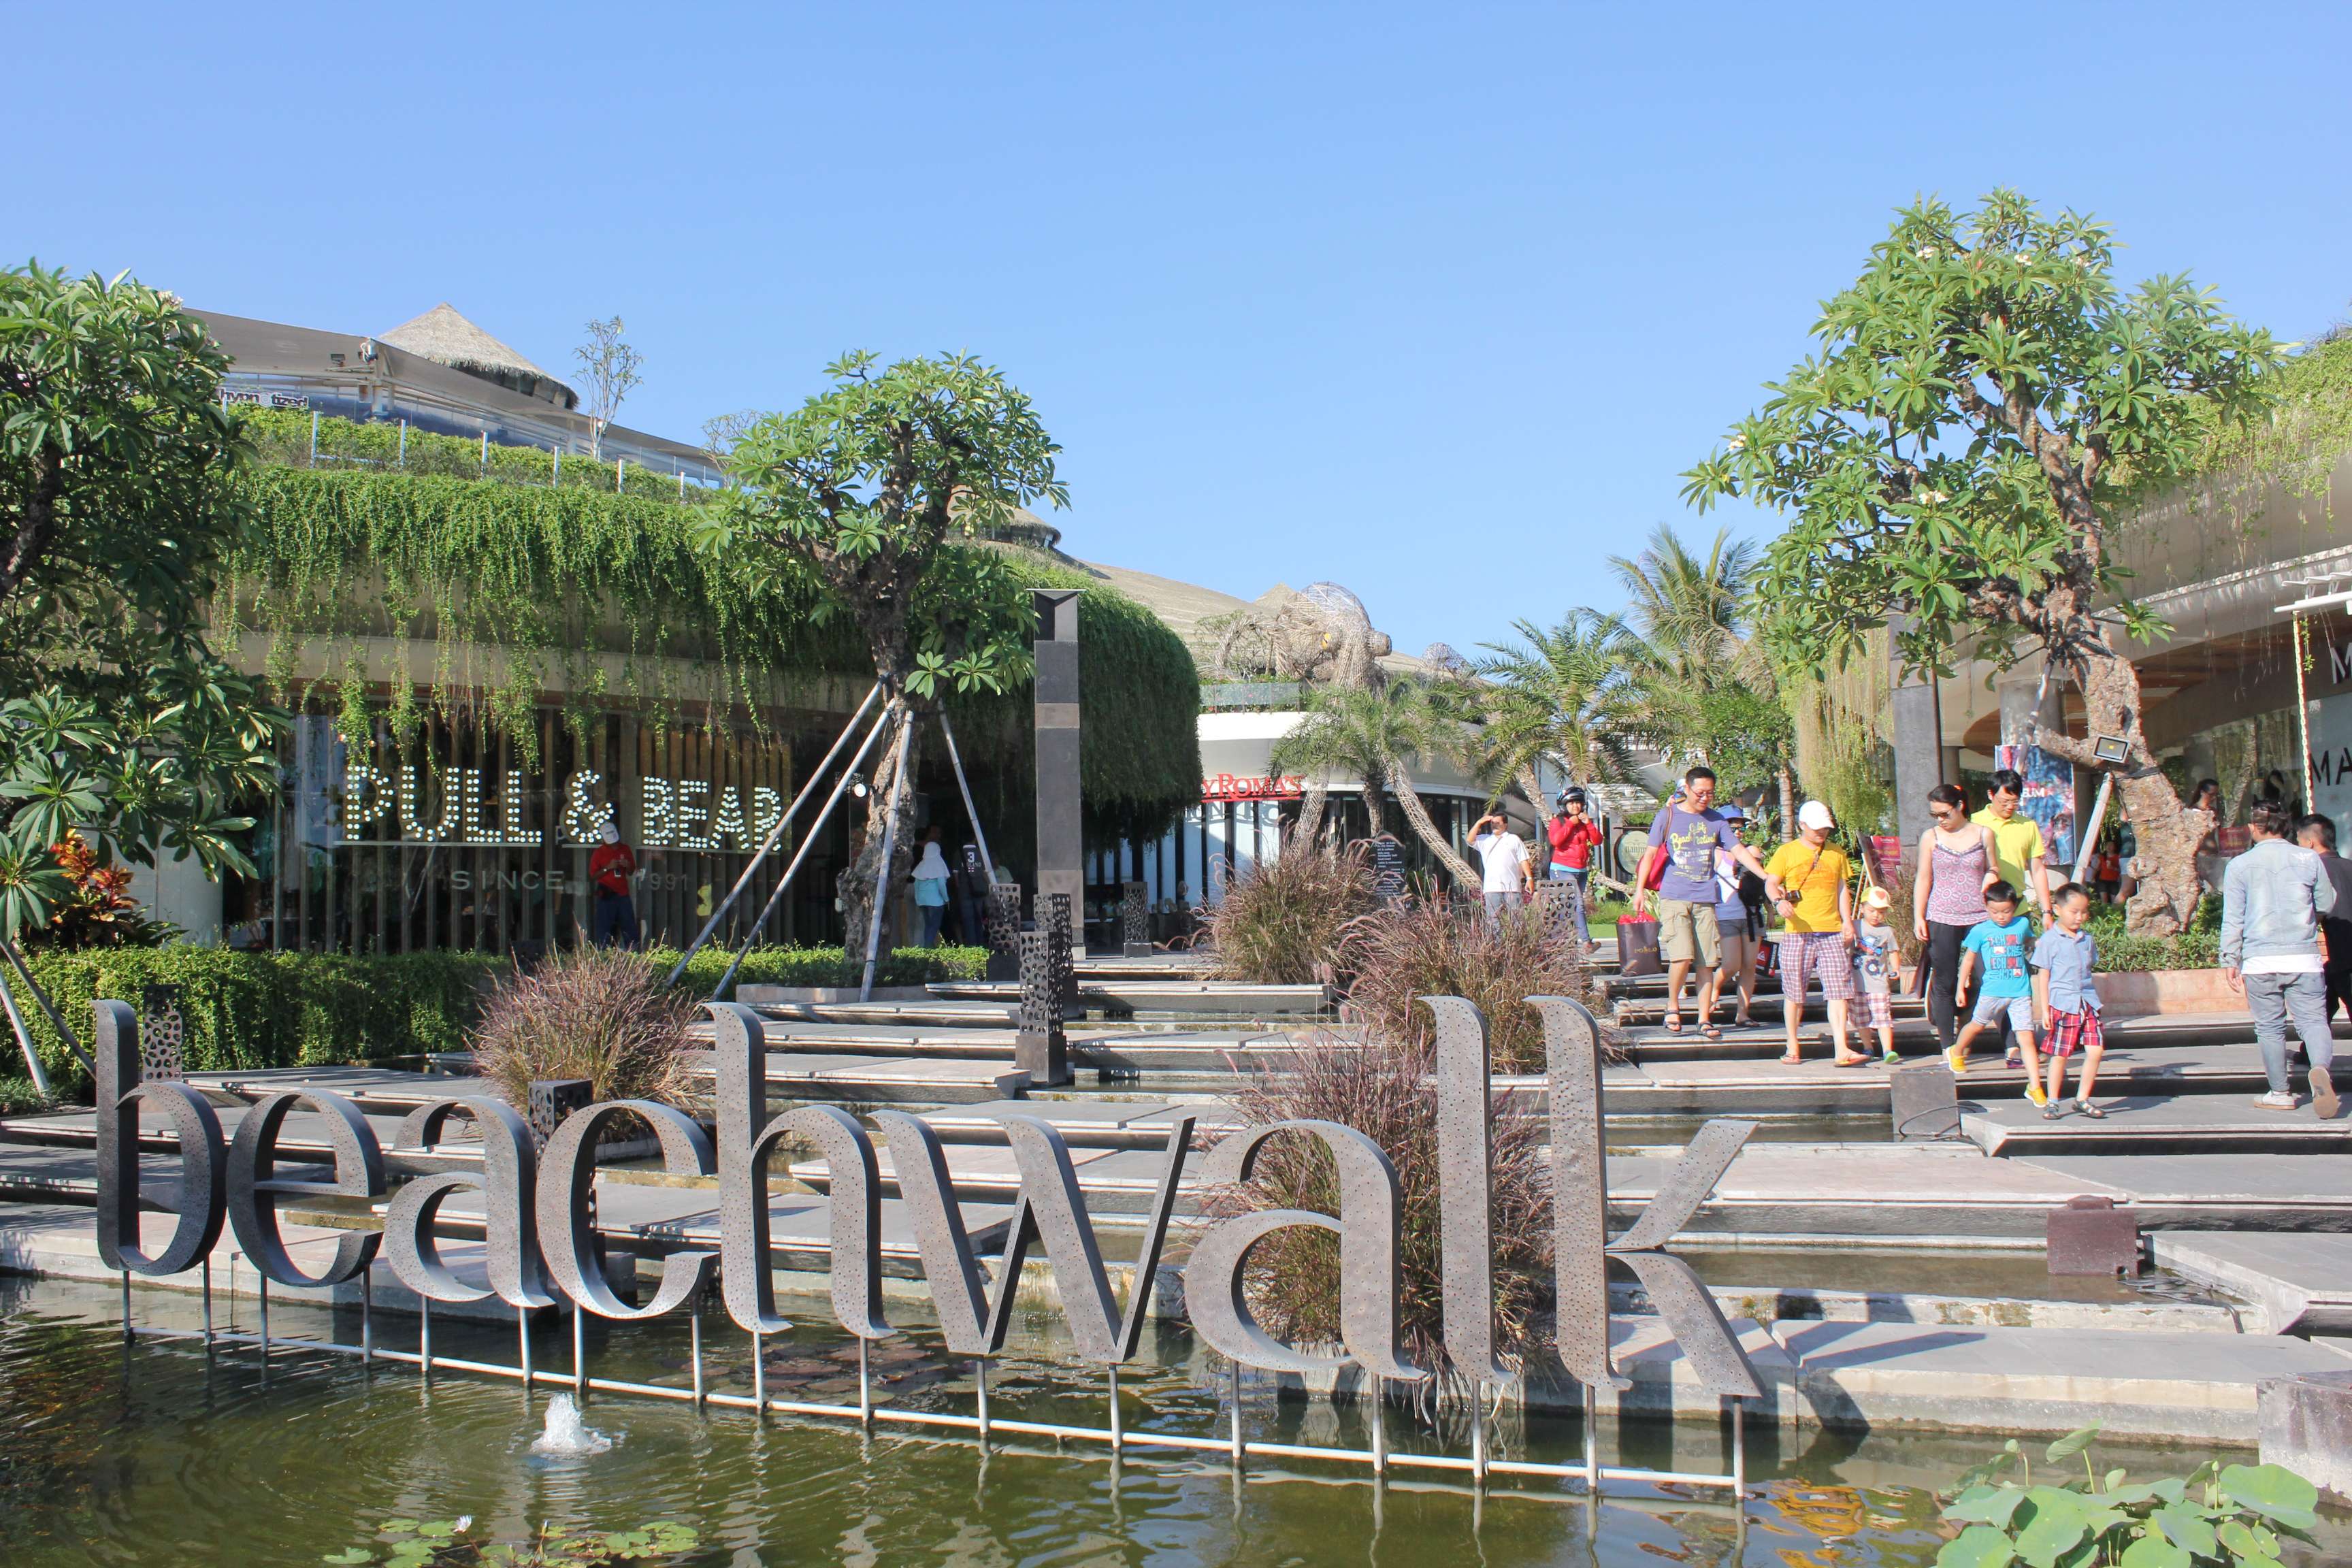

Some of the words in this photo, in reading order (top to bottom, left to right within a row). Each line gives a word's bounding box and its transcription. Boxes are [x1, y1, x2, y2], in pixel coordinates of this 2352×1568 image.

[344, 764, 542, 844] PULL
[561, 768, 615, 844] &
[642, 775, 783, 851] BEAR
[451, 870, 565, 891] SINCE
[967, 851, 975, 863] 3
[91, 995, 1761, 1398] beachwalk
